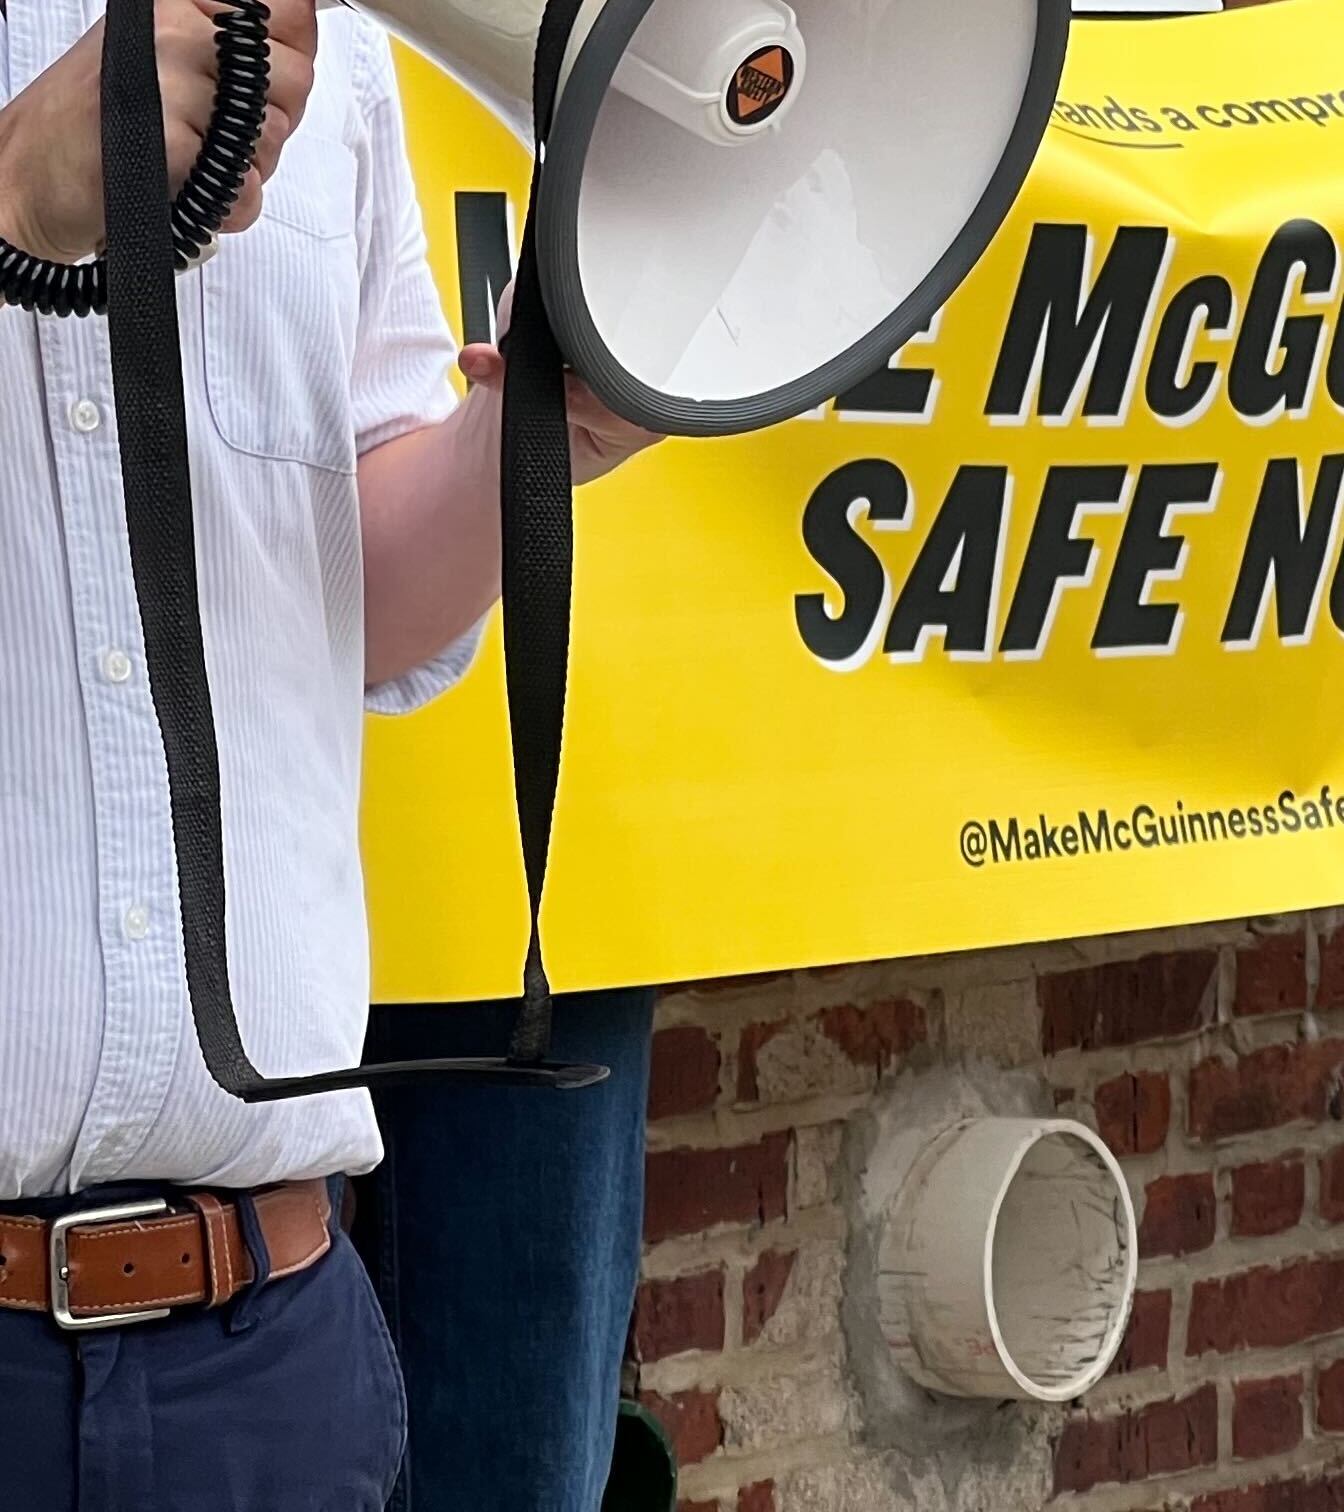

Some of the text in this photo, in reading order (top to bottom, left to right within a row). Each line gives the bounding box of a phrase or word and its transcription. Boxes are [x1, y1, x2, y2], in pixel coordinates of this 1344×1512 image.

[1052, 95, 1163, 134] ands
[1160, 106, 1200, 131] a
[793, 457, 1220, 671] SAFE
